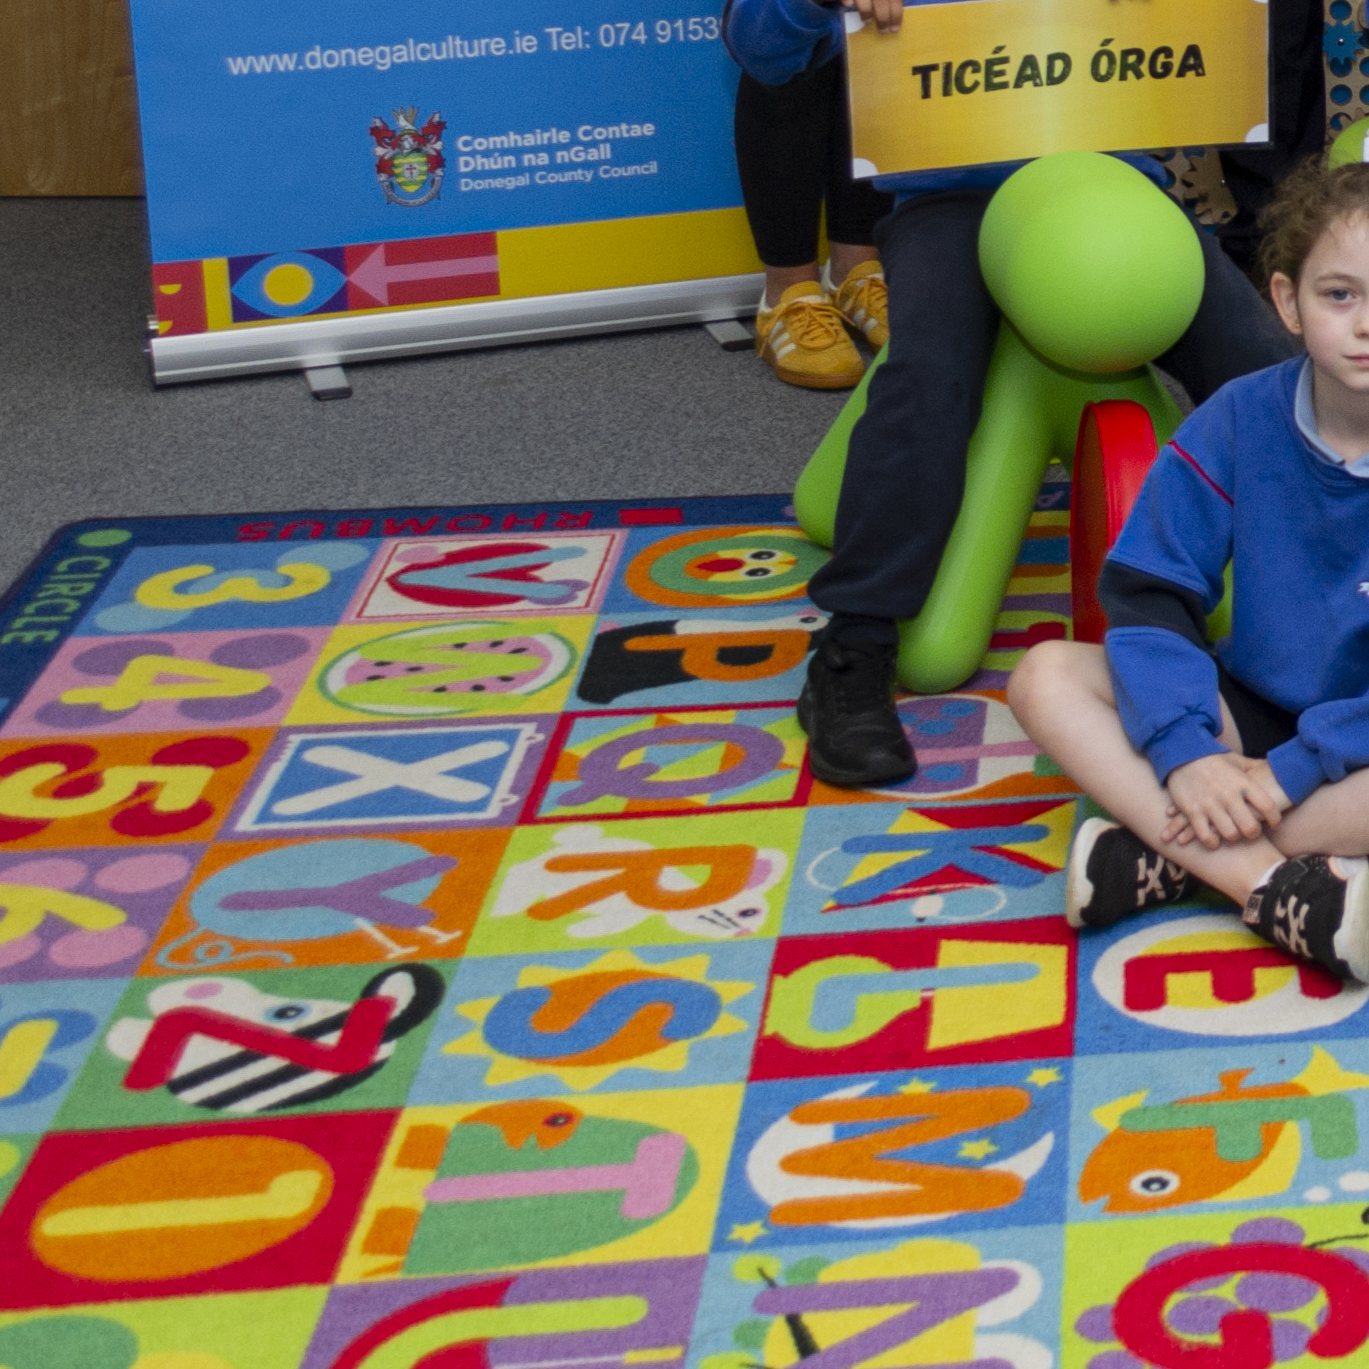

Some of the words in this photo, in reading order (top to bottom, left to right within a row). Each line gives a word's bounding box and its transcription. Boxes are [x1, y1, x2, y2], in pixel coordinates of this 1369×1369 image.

[226, 31, 538, 76] www.donegalculture.ie
[545, 27, 590, 52] Tel:
[599, 21, 648, 49] 074
[655, 14, 721, 44] 9153
[911, 45, 1073, 100] TICÉAD
[1089, 37, 1207, 84] ÓRGA
[457, 128, 571, 152] Comhairle
[577, 121, 656, 141] Contae
[458, 153, 517, 174] Dhún
[523, 153, 551, 166] na
[556, 143, 612, 164] nGall
[460, 172, 531, 193] Donegal
[534, 166, 595, 186] County
[598, 160, 659, 179] Council
[238, 509, 594, 541] RHOMBUS
[0, 556, 112, 645] CIRCLE
[134, 563, 332, 611] 3
[60, 654, 273, 711] 4
[624, 629, 811, 683] P
[272, 738, 511, 817] X
[218, 854, 459, 928] Y
[527, 844, 758, 920] R
[830, 825, 1050, 904] K
[482, 976, 723, 1060] S
[809, 962, 1041, 1034] L
[122, 994, 399, 1092] Z
[768, 1086, 1030, 1225] M
[1119, 1093, 1360, 1161] F
[422, 1132, 689, 1221] T
